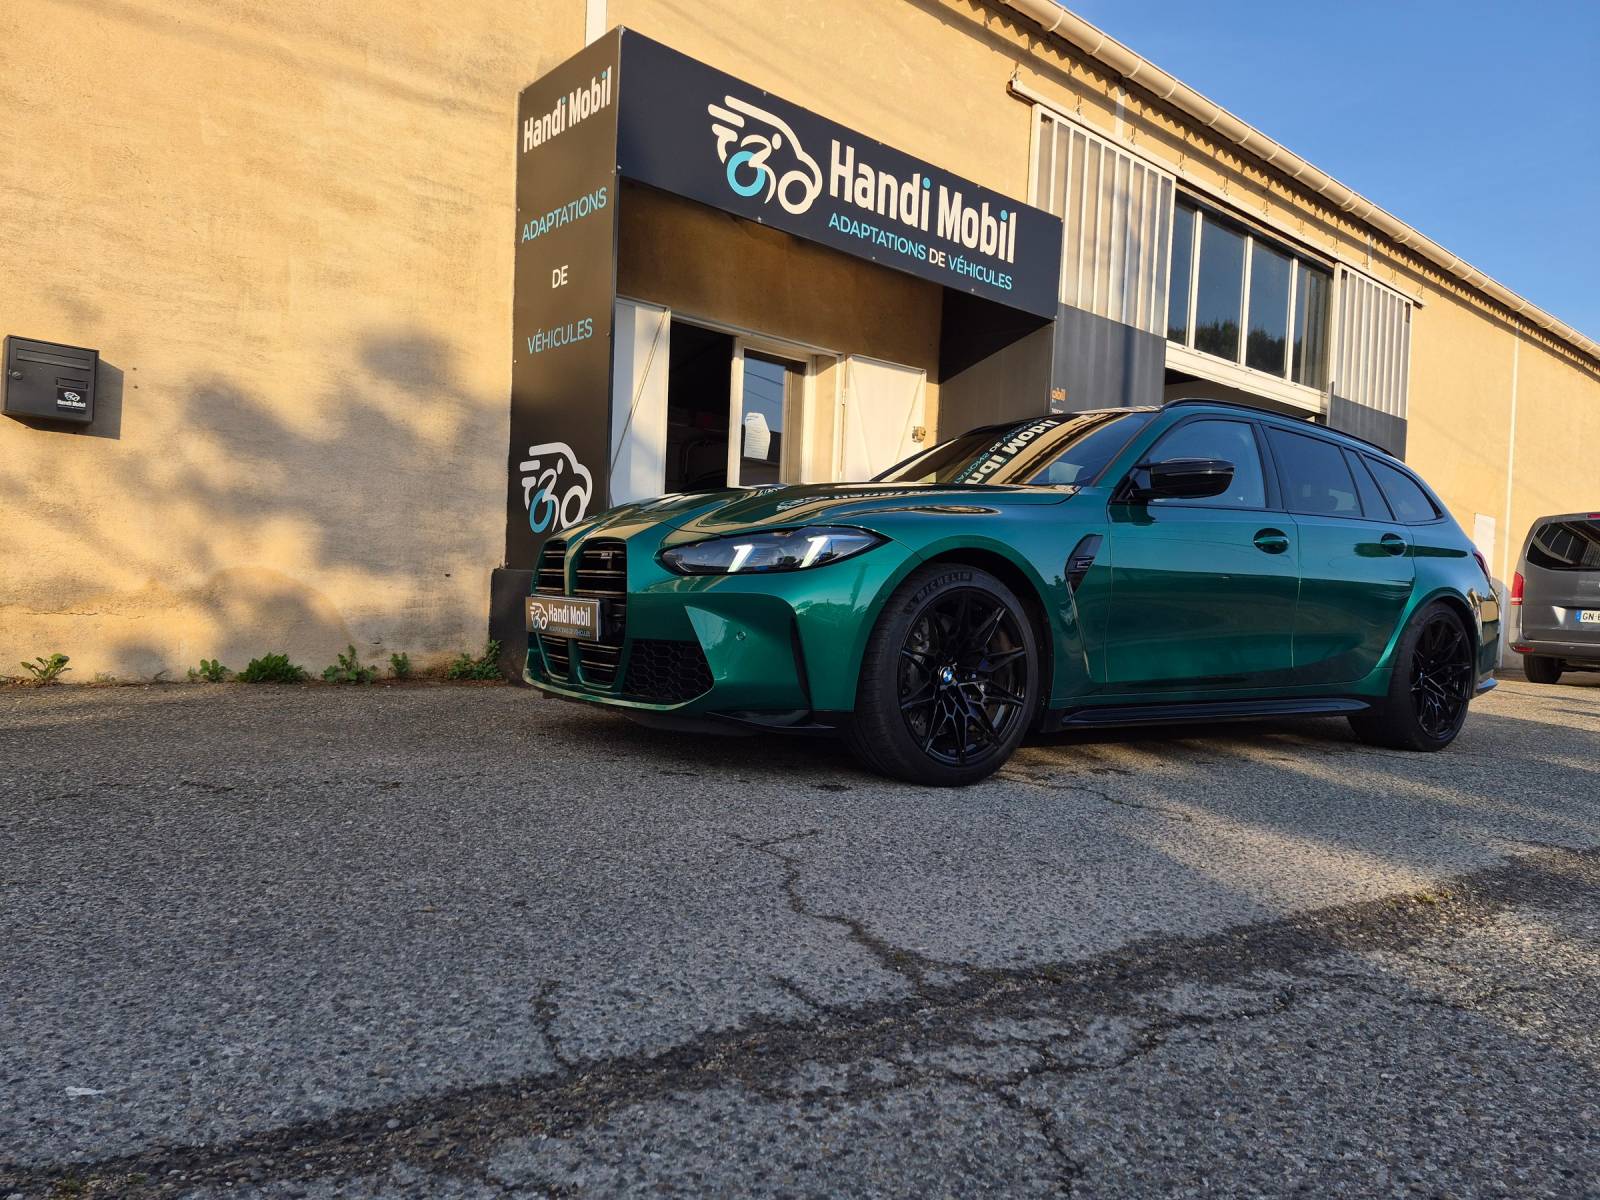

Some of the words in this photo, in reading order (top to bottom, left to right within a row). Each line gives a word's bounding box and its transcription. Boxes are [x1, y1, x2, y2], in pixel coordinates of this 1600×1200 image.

[523, 96, 566, 153] Handi
[568, 66, 612, 128] Mobil
[521, 187, 607, 244] ADAPTATIONS
[829, 138, 931, 232] Handi
[937, 184, 1017, 264] Mobil
[552, 264, 569, 289] DE
[828, 212, 927, 260] ADAPTATIONS
[929, 247, 946, 268] DE
[948, 254, 1013, 291] VÉHICULES
[527, 317, 593, 355] VÉHICULES
[548, 603, 569, 624] Handi
[570, 605, 591, 627] Mobil
